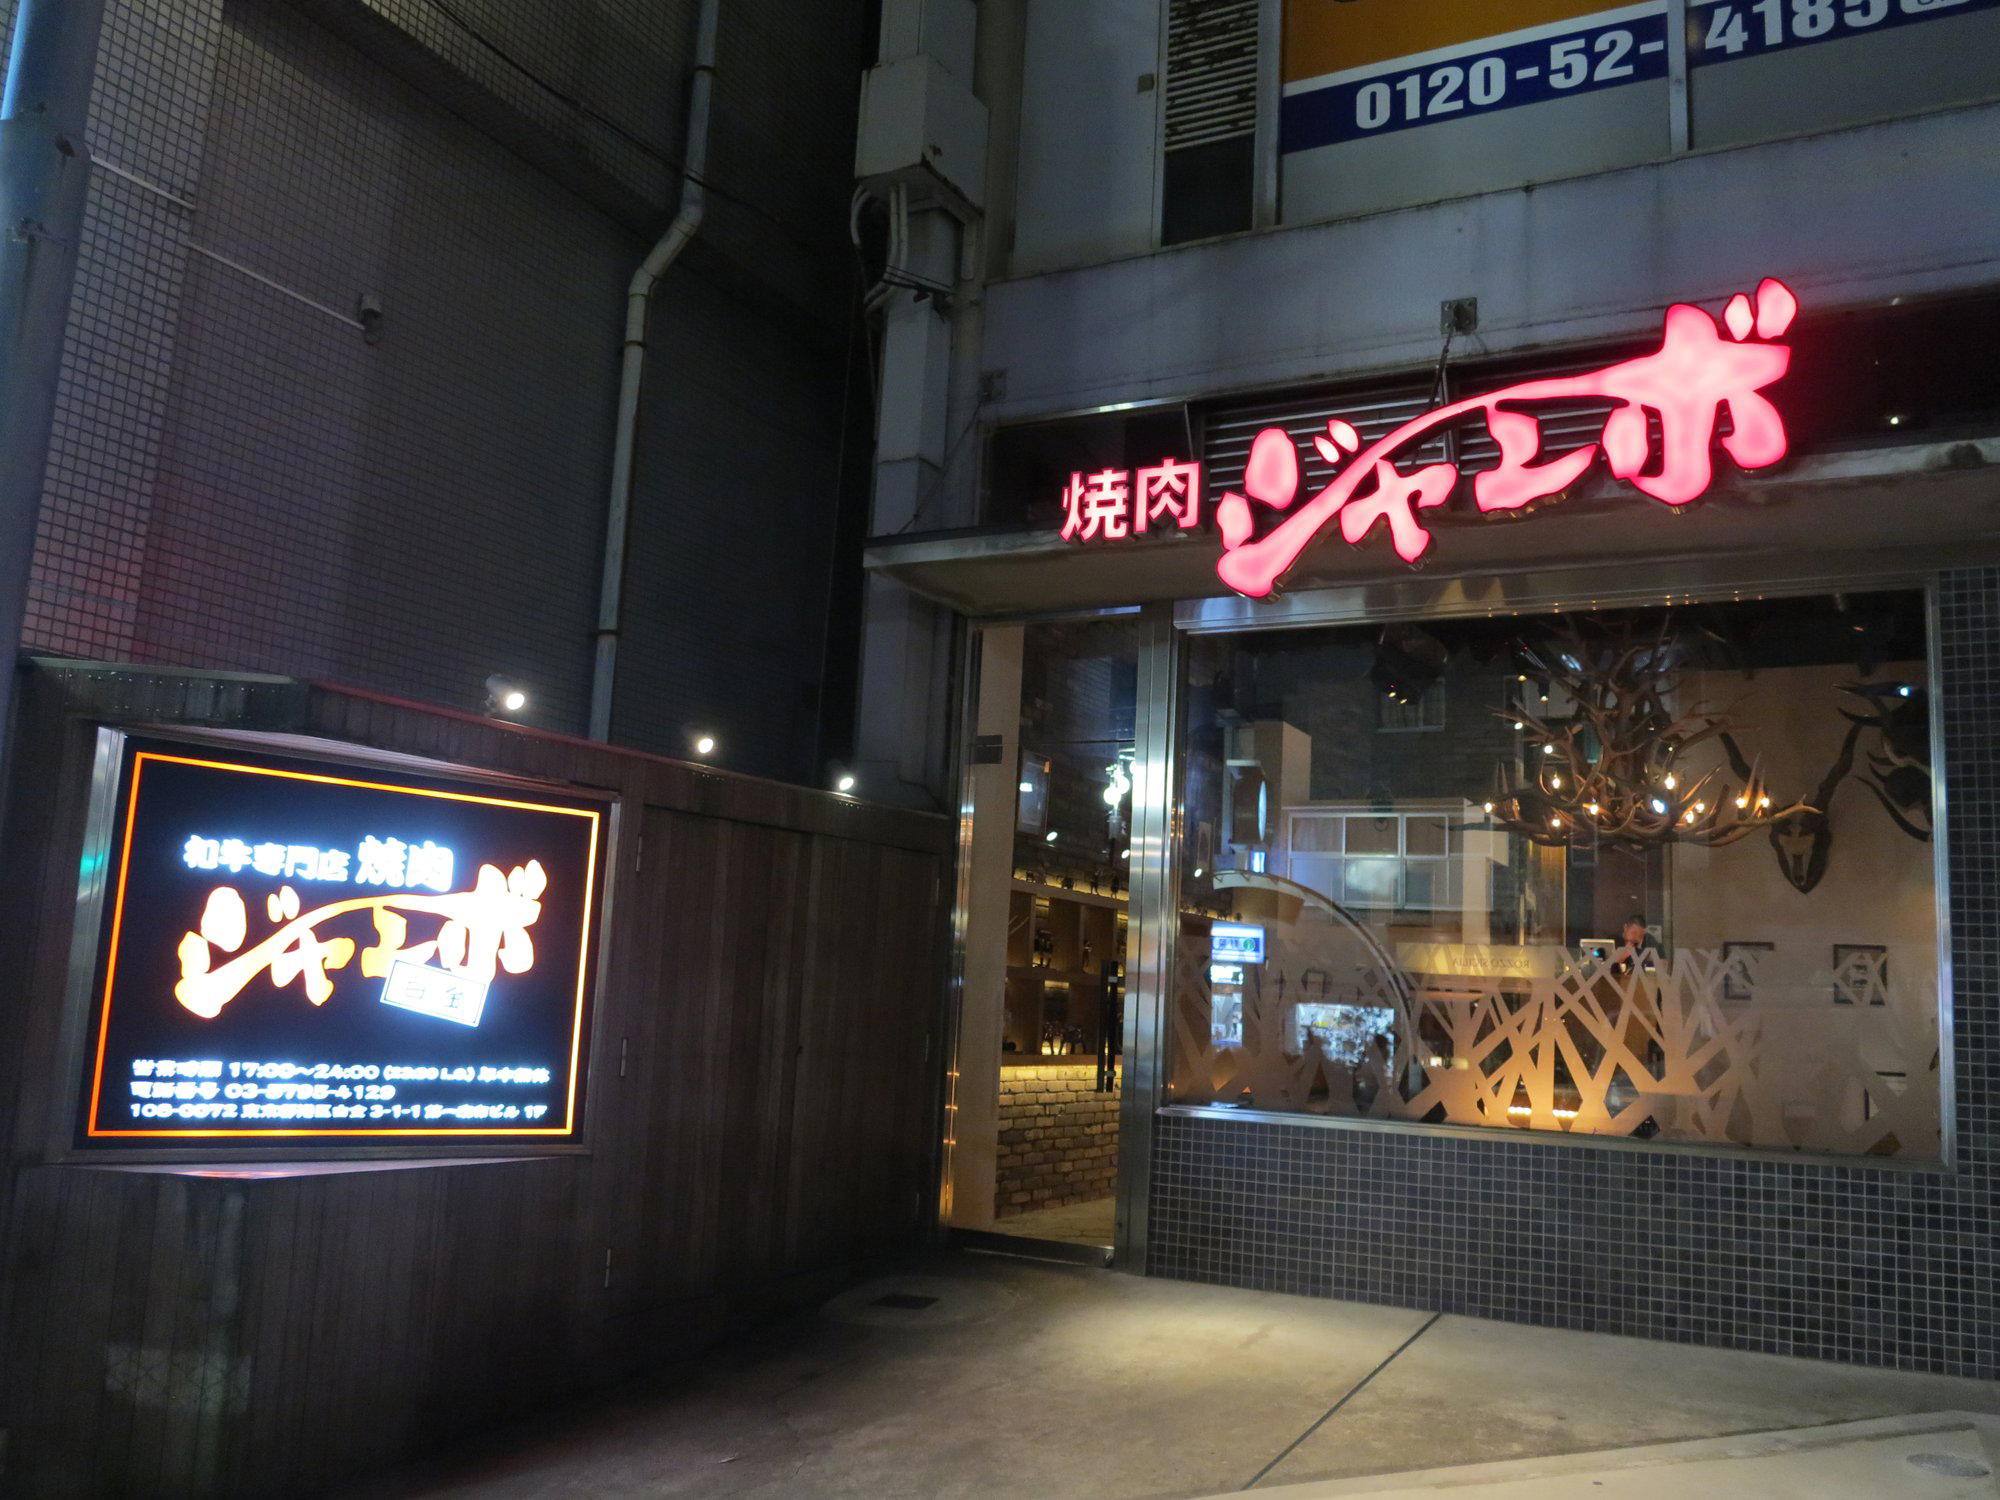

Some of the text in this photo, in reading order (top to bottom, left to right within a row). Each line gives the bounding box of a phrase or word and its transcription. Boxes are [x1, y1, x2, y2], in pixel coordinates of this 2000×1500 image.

[1059, 457, 1201, 542] 焼肉
[183, 834, 454, 892] 和牛専門店 焼肉
